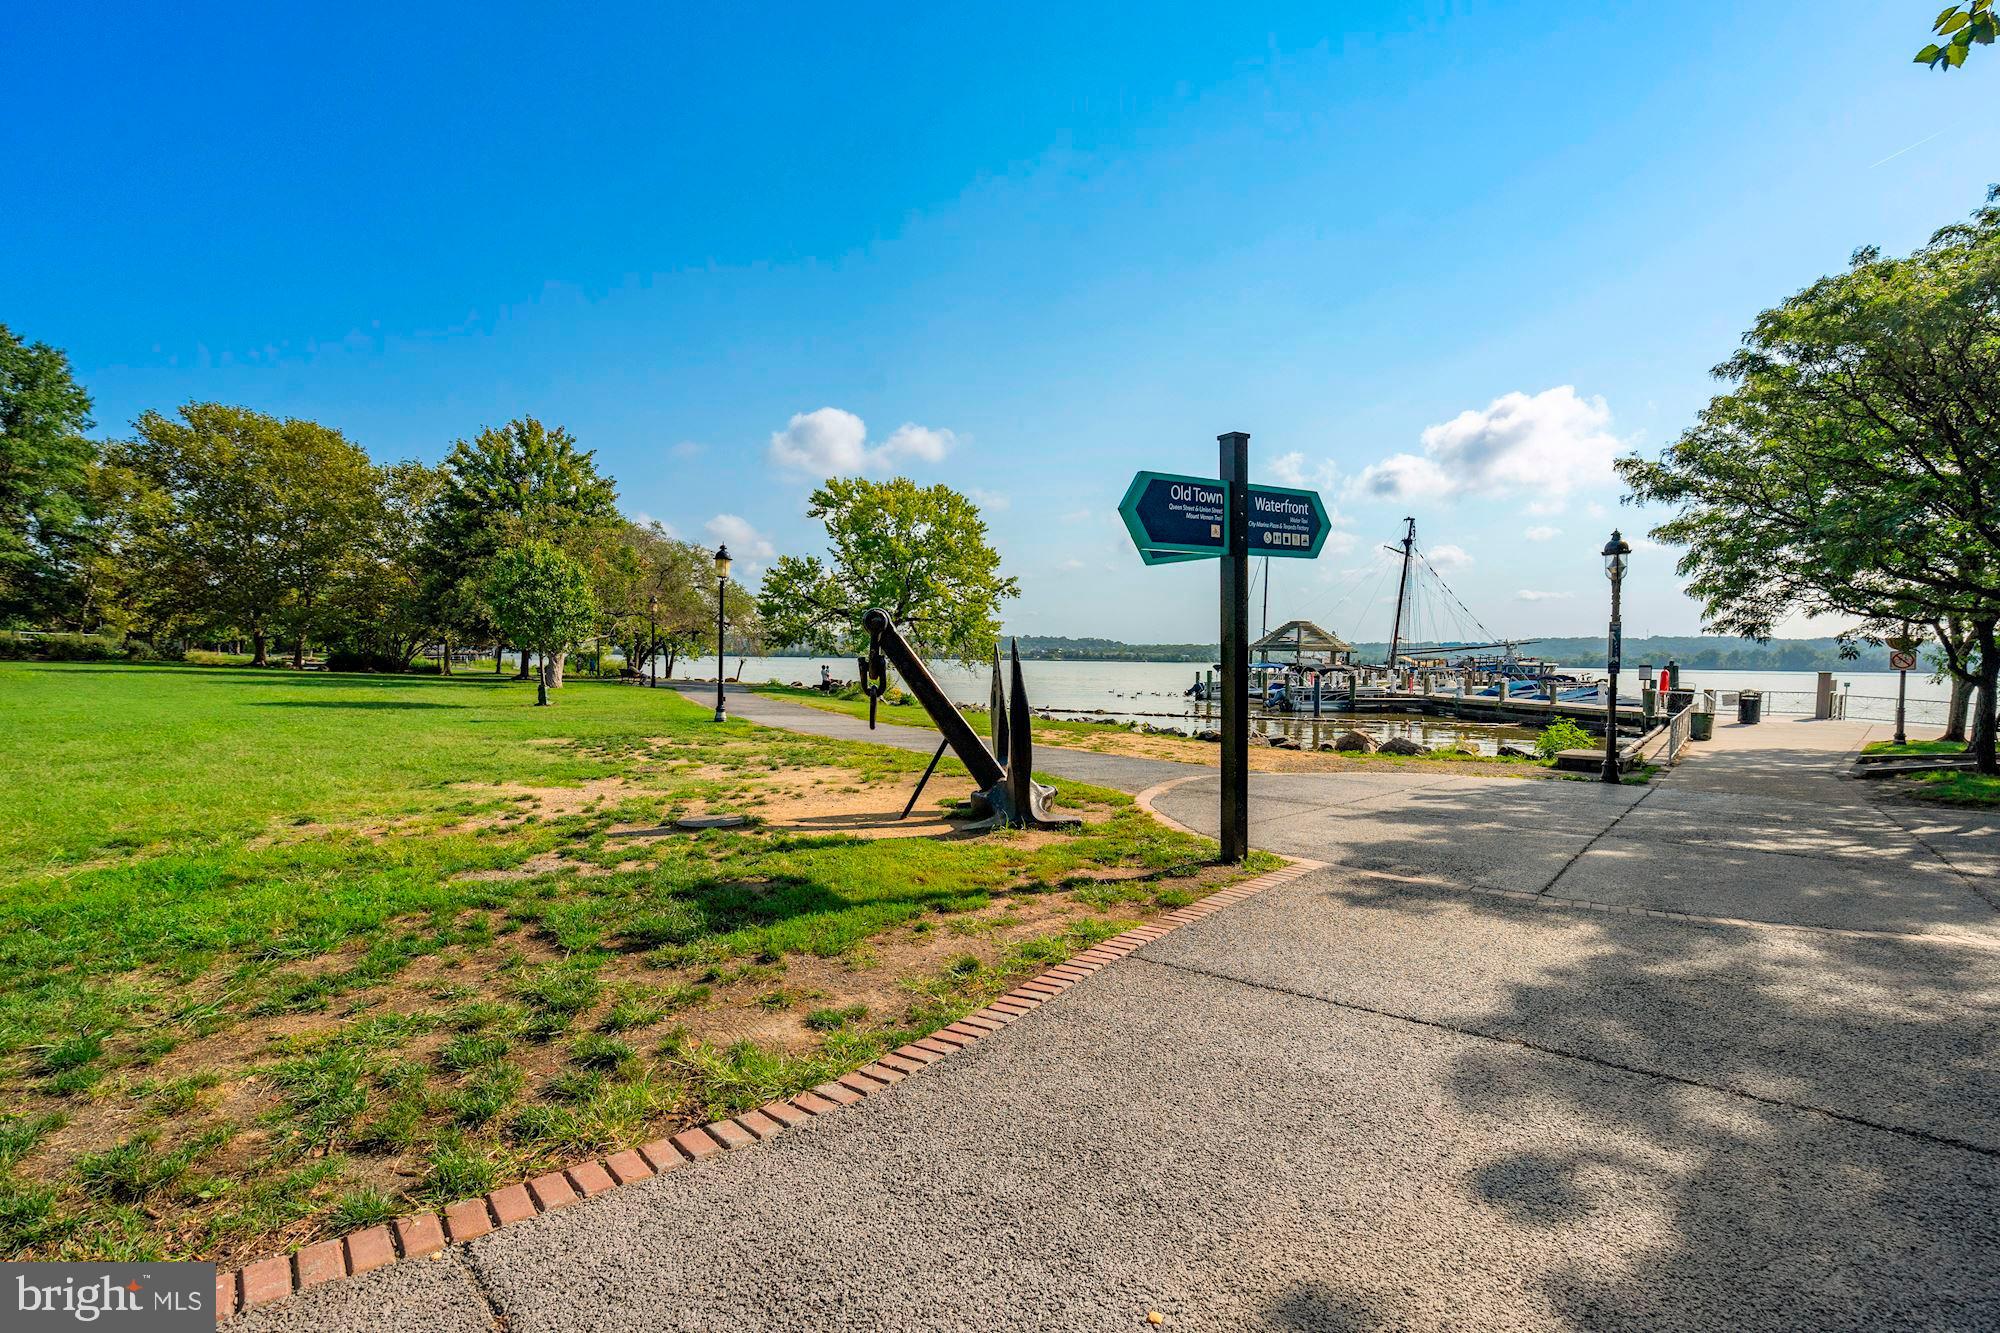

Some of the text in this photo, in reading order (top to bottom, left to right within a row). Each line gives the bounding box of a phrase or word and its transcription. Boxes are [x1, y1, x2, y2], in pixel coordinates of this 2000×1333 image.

[1170, 484, 1223, 504] Old Town
[1254, 496, 1309, 515] Waterfront
